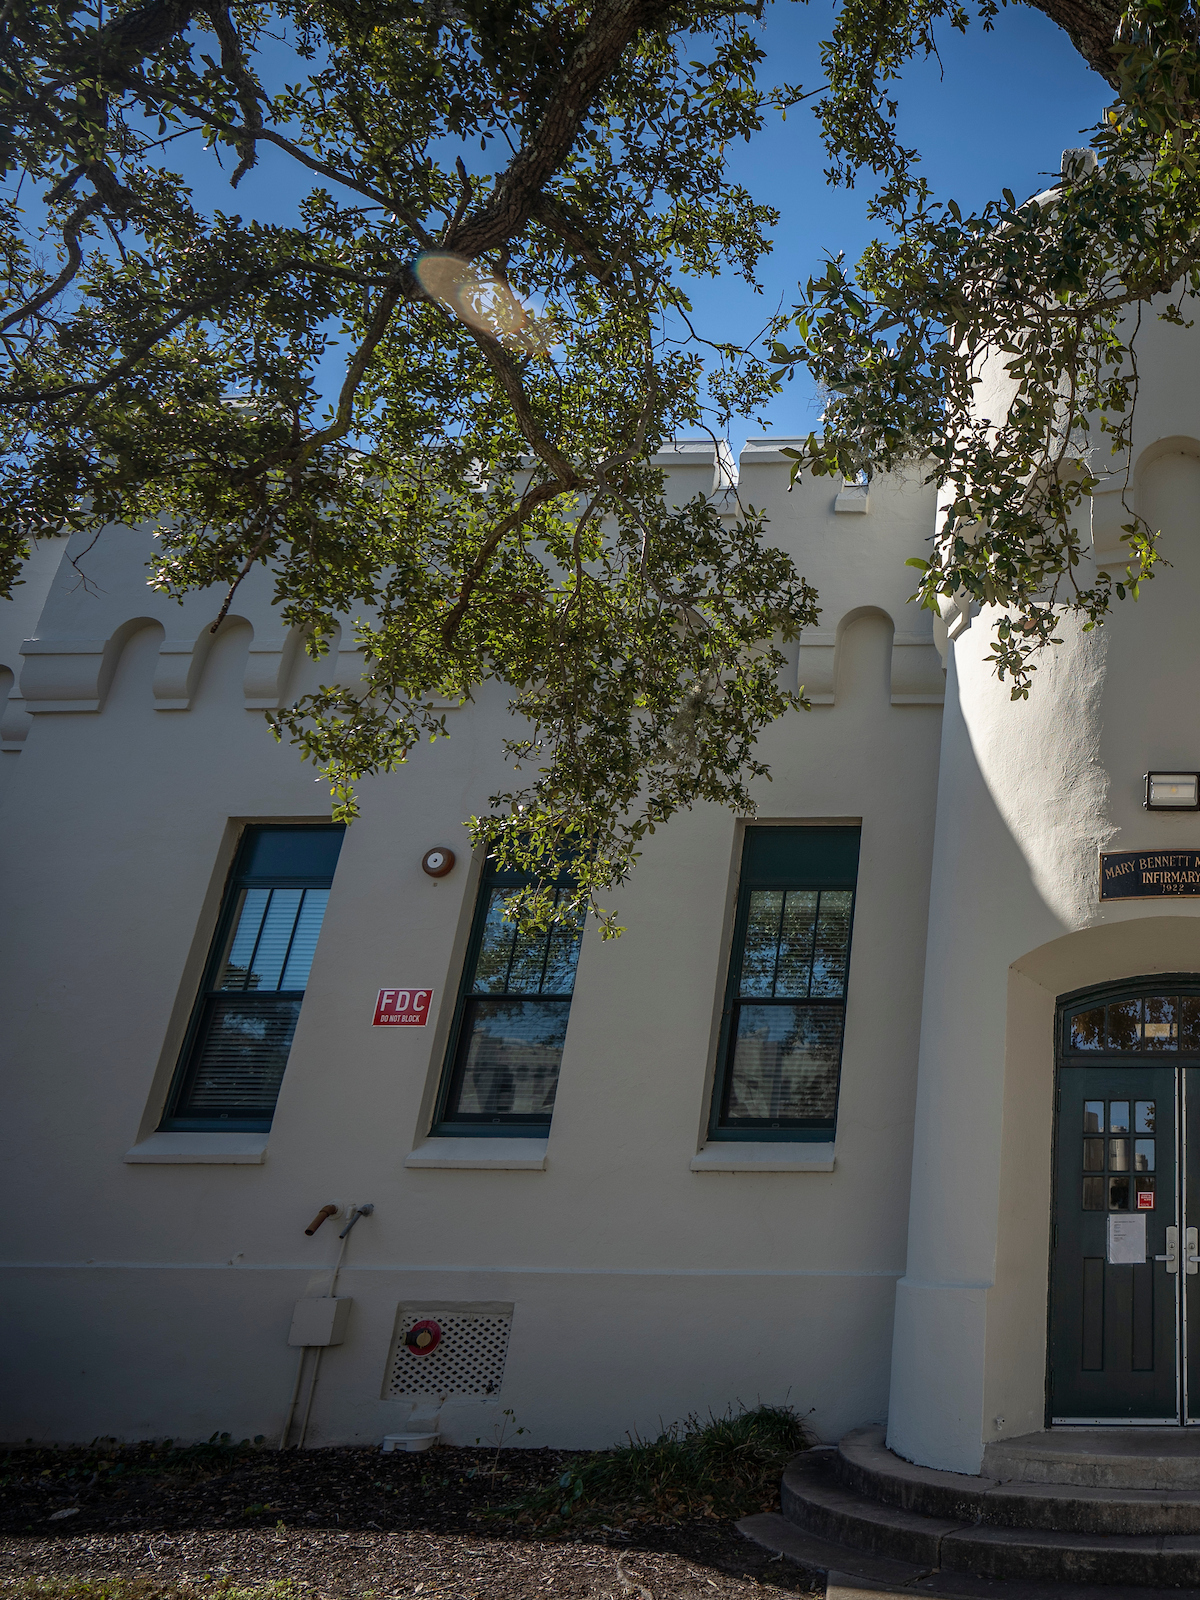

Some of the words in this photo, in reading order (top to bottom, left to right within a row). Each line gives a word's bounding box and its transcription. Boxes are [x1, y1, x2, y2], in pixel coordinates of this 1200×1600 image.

[1104, 860, 1136, 880] MARY
[1139, 855, 1192, 870] BENNETT
[1162, 883, 1185, 892] 1922
[380, 991, 427, 1012] FDC
[380, 1014, 389, 1023] DO
[389, 1014, 401, 1023] NOT
[401, 1014, 421, 1023] BLOCK
